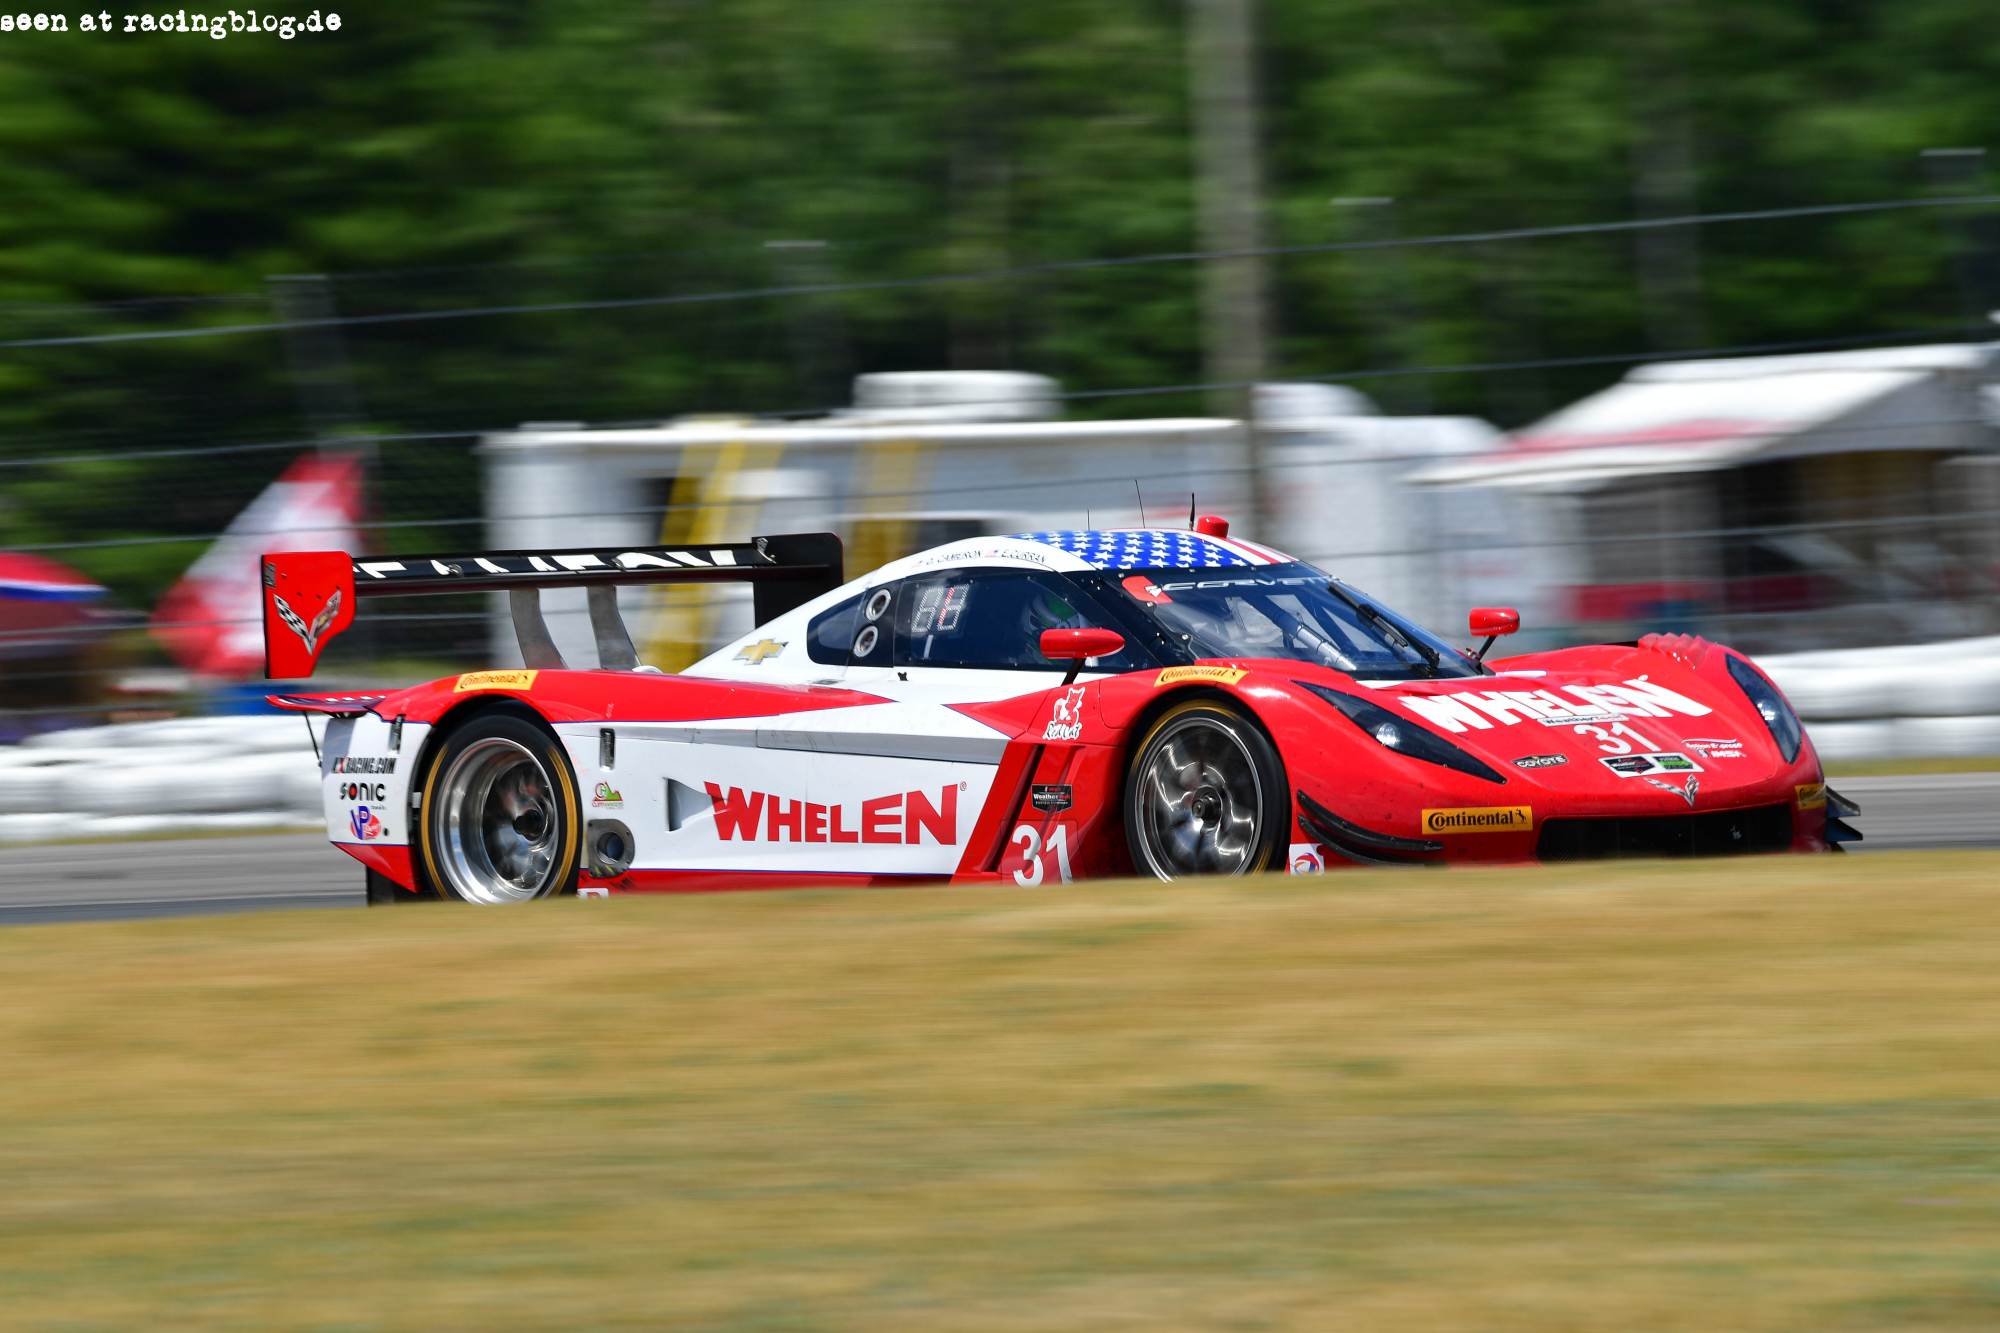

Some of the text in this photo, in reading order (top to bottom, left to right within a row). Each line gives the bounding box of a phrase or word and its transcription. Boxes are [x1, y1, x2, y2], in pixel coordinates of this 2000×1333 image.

[1398, 678, 1713, 733] WHELEN
[1573, 722, 1662, 755] 31
[704, 780, 959, 846] WHELEN
[1427, 810, 1514, 831] Continental
[1011, 824, 1073, 888] 31
